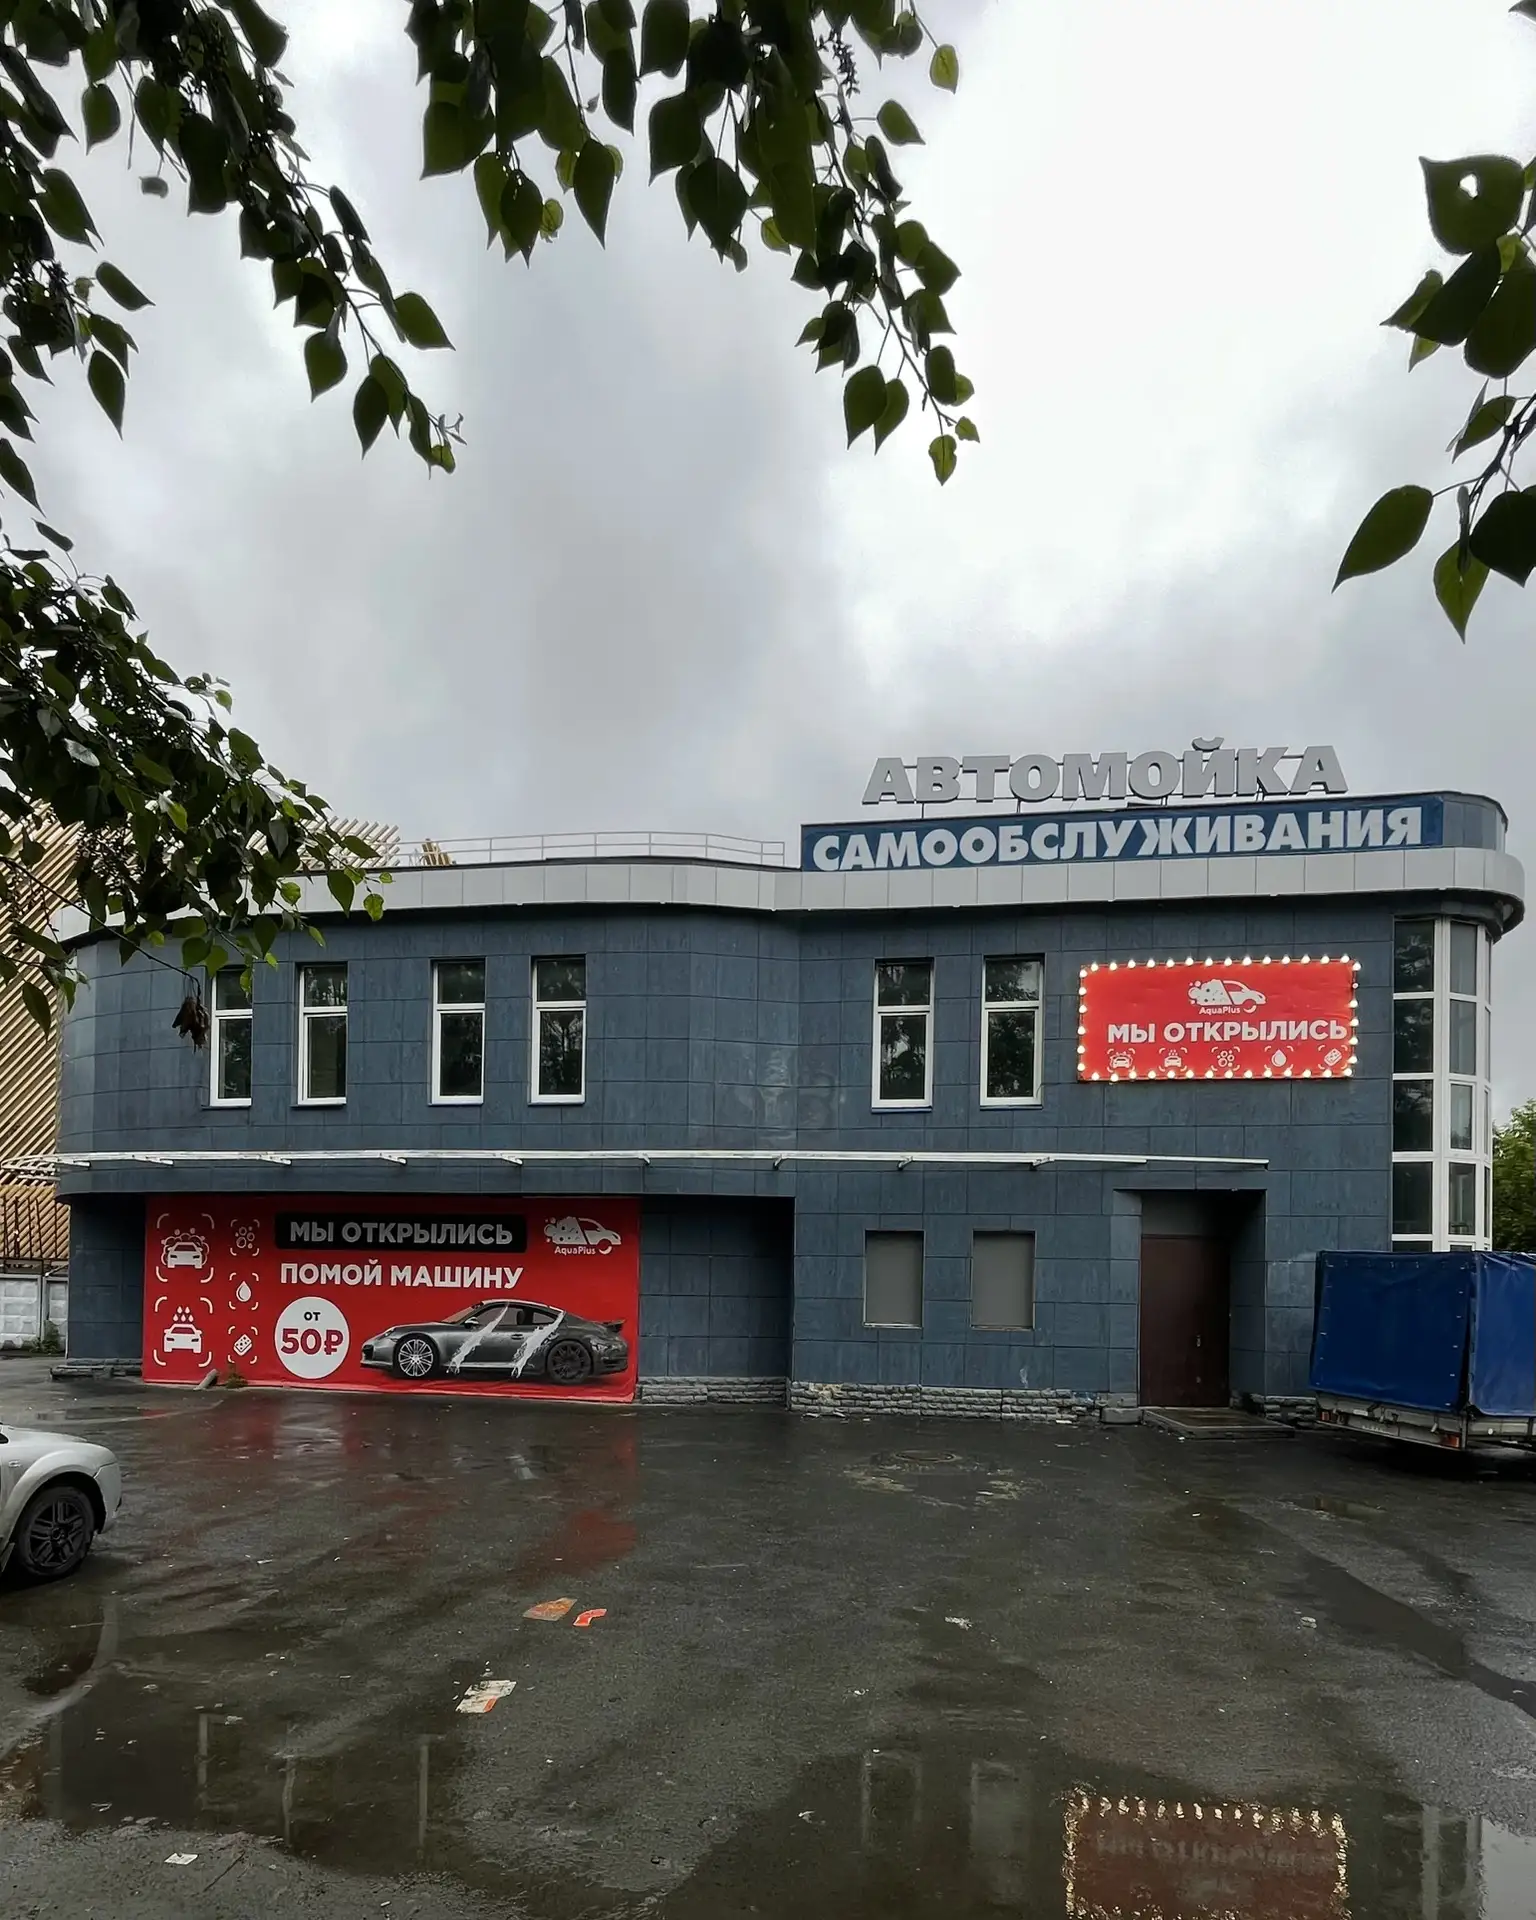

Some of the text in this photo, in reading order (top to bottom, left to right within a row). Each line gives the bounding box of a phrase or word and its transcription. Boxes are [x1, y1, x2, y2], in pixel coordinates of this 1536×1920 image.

[862, 737, 1349, 805] АВТОМОЙКА
[812, 806, 1422, 871] САМООБСЛУЖИВАНИЯ
[1198, 1005, 1241, 1016] AquaPlus
[1107, 1019, 1348, 1044] МЫ ОТКРЫЛИСЬ
[289, 1221, 514, 1245] МЫ ОТКРЫЛИСЬ
[554, 1245, 597, 1256] AquaPlus
[280, 1258, 524, 1290] ПОМОЙ МАШИНУ
[280, 1327, 344, 1356] 50₽
